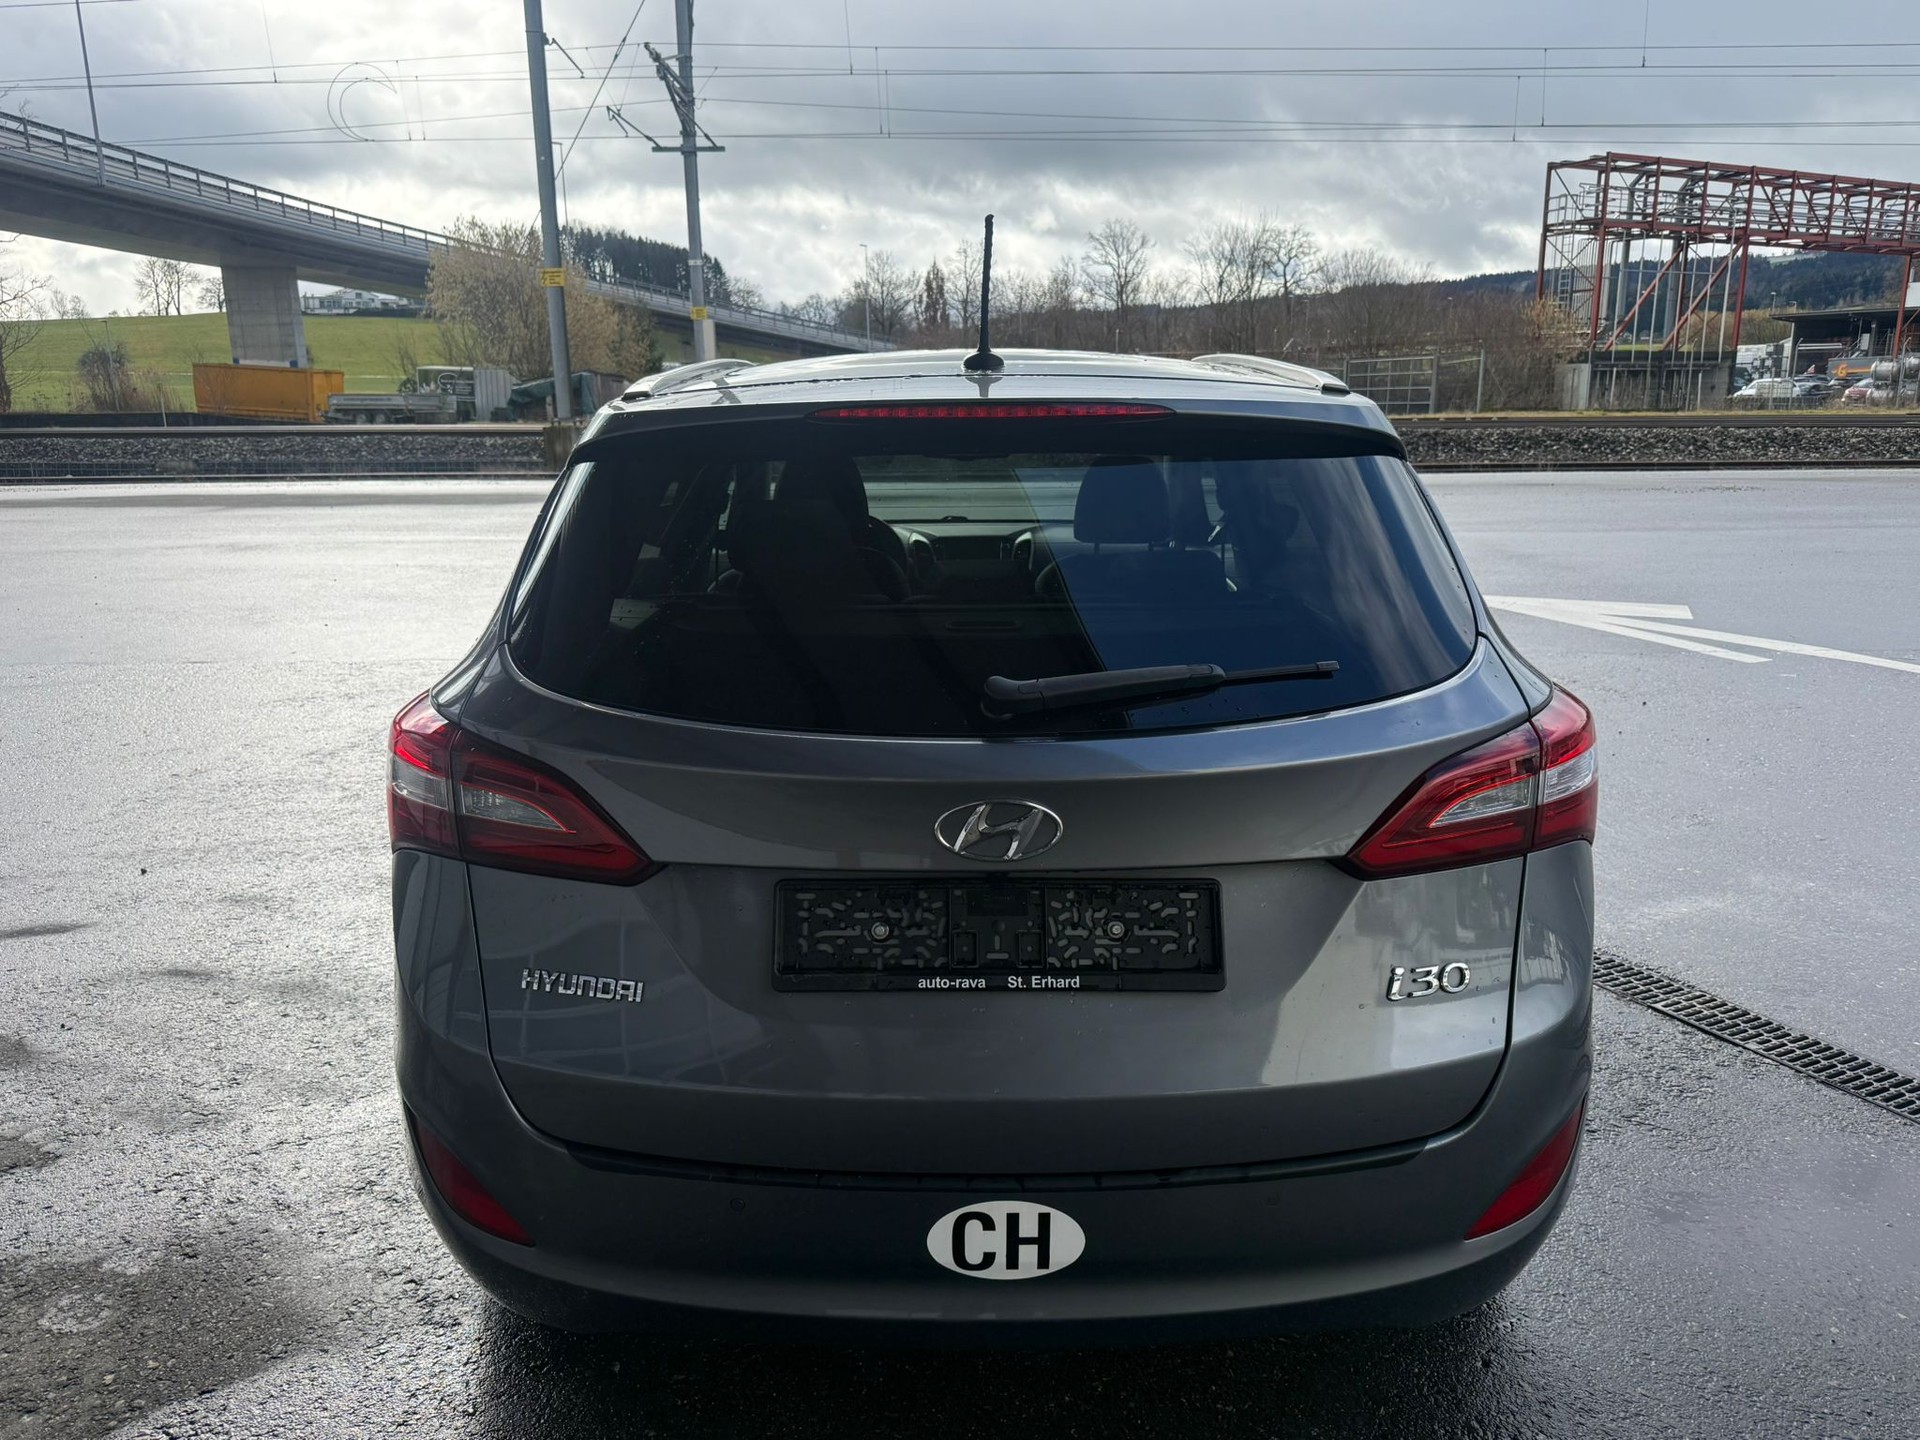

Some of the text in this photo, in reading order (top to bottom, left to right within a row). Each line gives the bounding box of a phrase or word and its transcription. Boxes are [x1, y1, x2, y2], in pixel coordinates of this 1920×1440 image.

[521, 968, 644, 1003] HYUNDAI
[918, 975, 1080, 989] auto-rava St. Erhard
[1387, 962, 1471, 1001] i30
[951, 1211, 1051, 1271] CH
